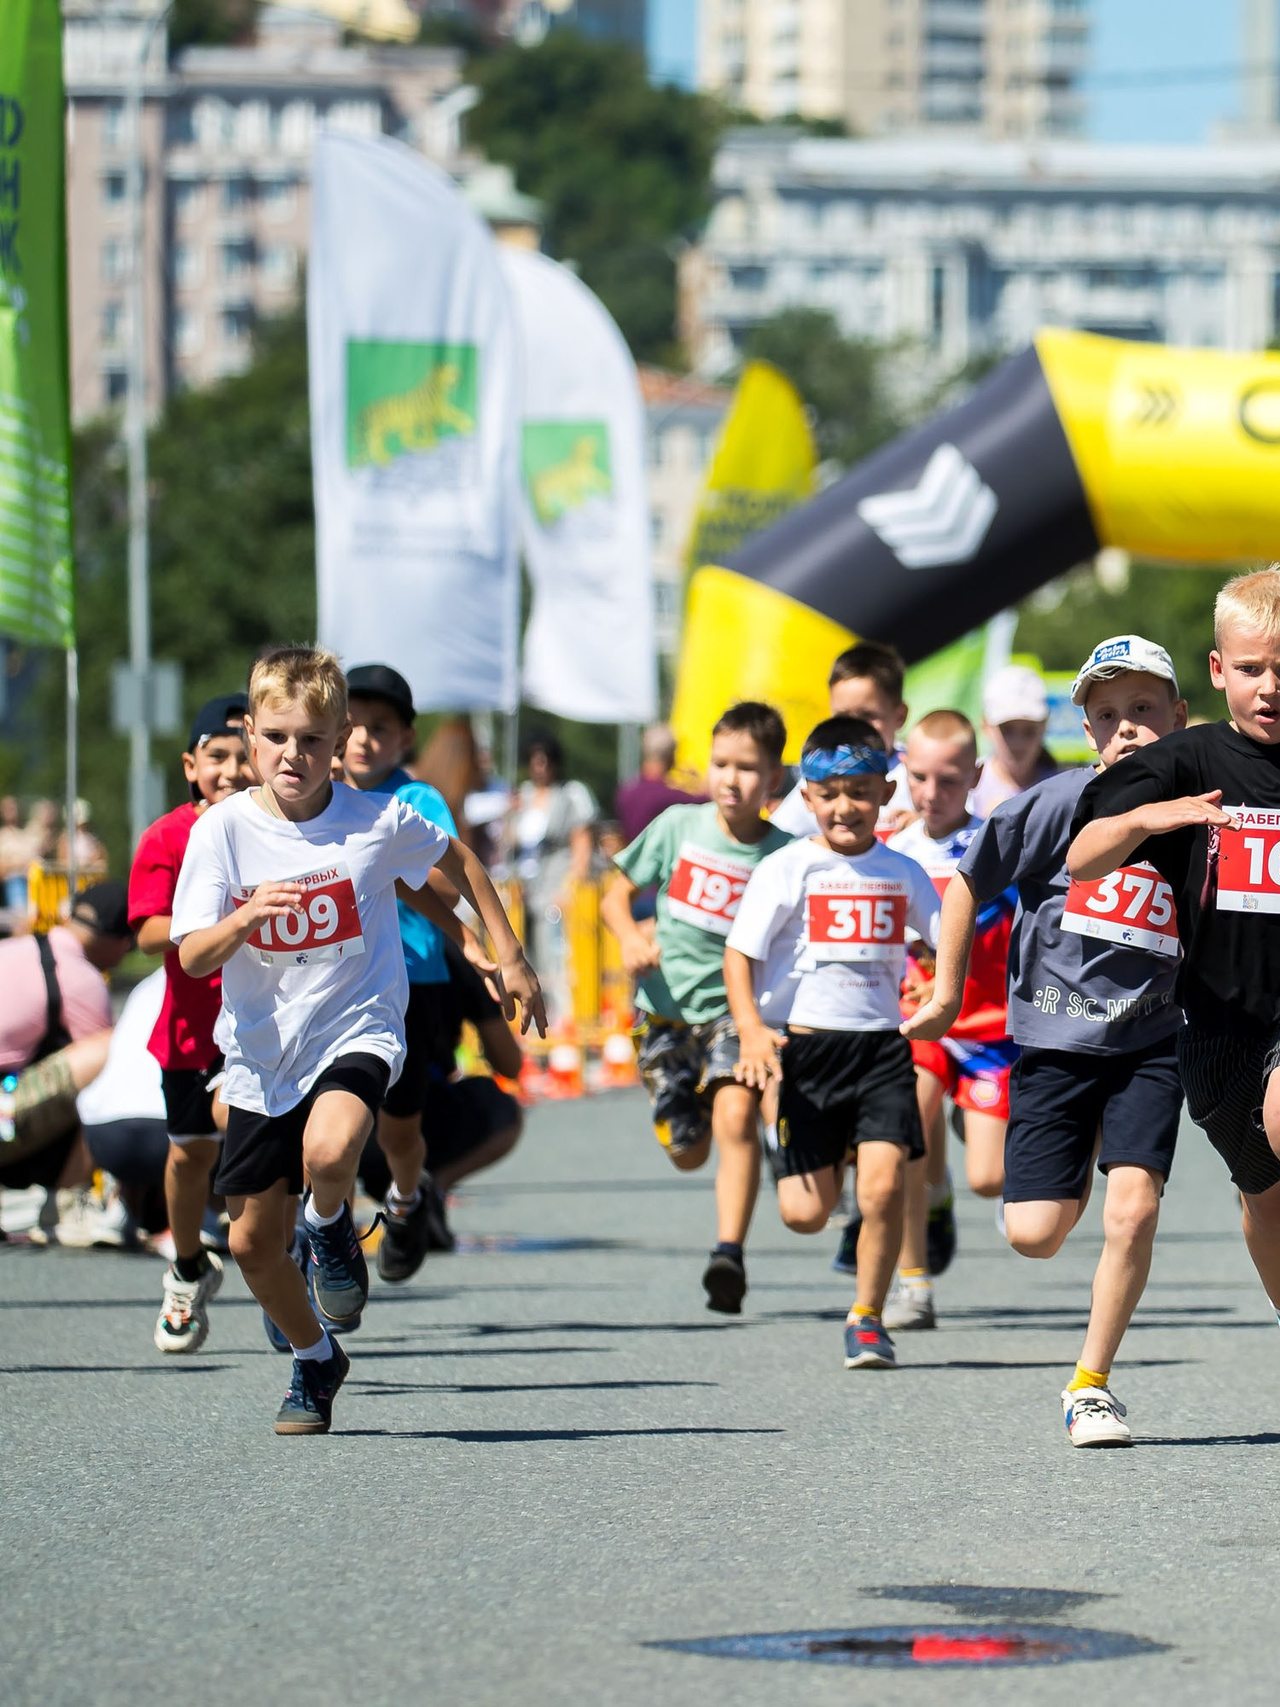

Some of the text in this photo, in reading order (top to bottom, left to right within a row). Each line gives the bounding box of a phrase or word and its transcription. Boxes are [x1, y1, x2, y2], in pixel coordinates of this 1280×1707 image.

[291, 868, 339, 886] ЕРВЫХ
[1085, 871, 1173, 926] 375
[260, 894, 339, 945] 109
[826, 899, 894, 940] 315
